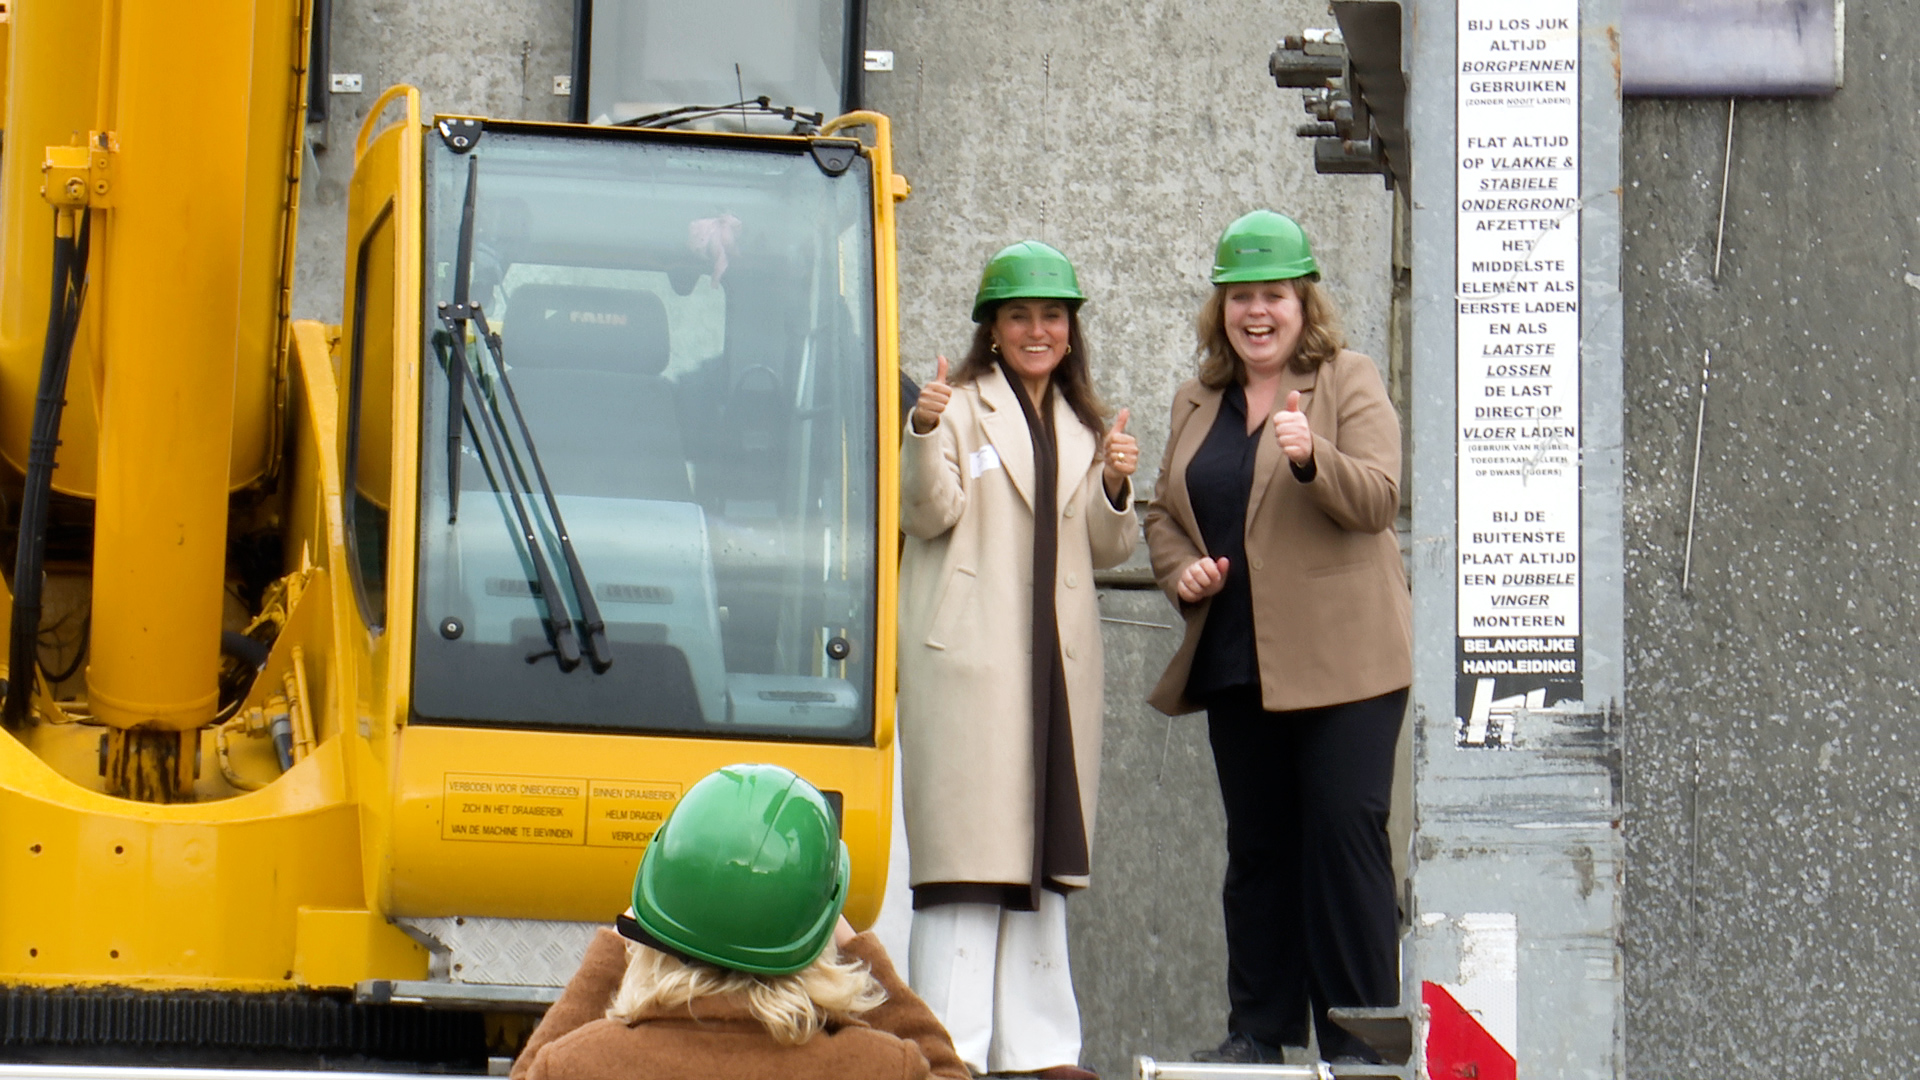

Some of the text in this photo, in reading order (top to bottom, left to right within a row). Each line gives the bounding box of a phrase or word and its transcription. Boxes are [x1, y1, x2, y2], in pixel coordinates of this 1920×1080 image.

[1468, 19, 1568, 31] BIJ LOS JUK
[1490, 40, 1546, 51] ALTIJD
[1462, 60, 1575, 72] BORGPENNEN
[1470, 81, 1565, 92] GEBRUIKEN
[1507, 98, 1533, 106] NOOIT
[1468, 136, 1568, 148] FLAT ALTIJD
[1463, 157, 1572, 169] OP VLAKKE &
[1480, 178, 1557, 190] STABIELE
[1462, 198, 1577, 211] ONDERGROND
[1476, 219, 1560, 231] AFZETTEN
[1503, 240, 1534, 251] HET
[1472, 261, 1564, 272] MIDDELSTE
[1463, 281, 1574, 293] ELEMENT ALS
[1460, 302, 1576, 314] EERSTE LADEN
[1490, 323, 1547, 334] EN ALS
[1483, 344, 1555, 355] LAATSTE
[1487, 365, 1551, 377] LOSSEN
[1485, 385, 1551, 397] DE LAST
[1475, 406, 1562, 417] DIRECT OP
[1464, 427, 1575, 438] VLOER LADEN
[1468, 444, 1510, 452] (GEBRUIK
[1493, 512, 1544, 522] BIJ DE
[1473, 532, 1564, 543] BUITENSTE
[1463, 553, 1575, 564] PLAAT ALTIJD
[1465, 574, 1574, 586] EEN DUBBELE
[1491, 595, 1549, 606] VINGER
[1474, 616, 1564, 627] MONTEREN
[1464, 638, 1575, 652] BELANGRIJKE
[1463, 659, 1575, 673] HANDLEIDING!
[449, 782, 579, 796] VERBODEN VOOR ONBEVOEGDEN
[594, 788, 676, 800] BINNEN DRAAIBEREIK
[463, 803, 564, 816] ZICH IN HET DRAAIBEREIK
[606, 810, 662, 820] HELM DRAGEN
[451, 825, 573, 838] VAN DE MACHINE TE BEVINDEN
